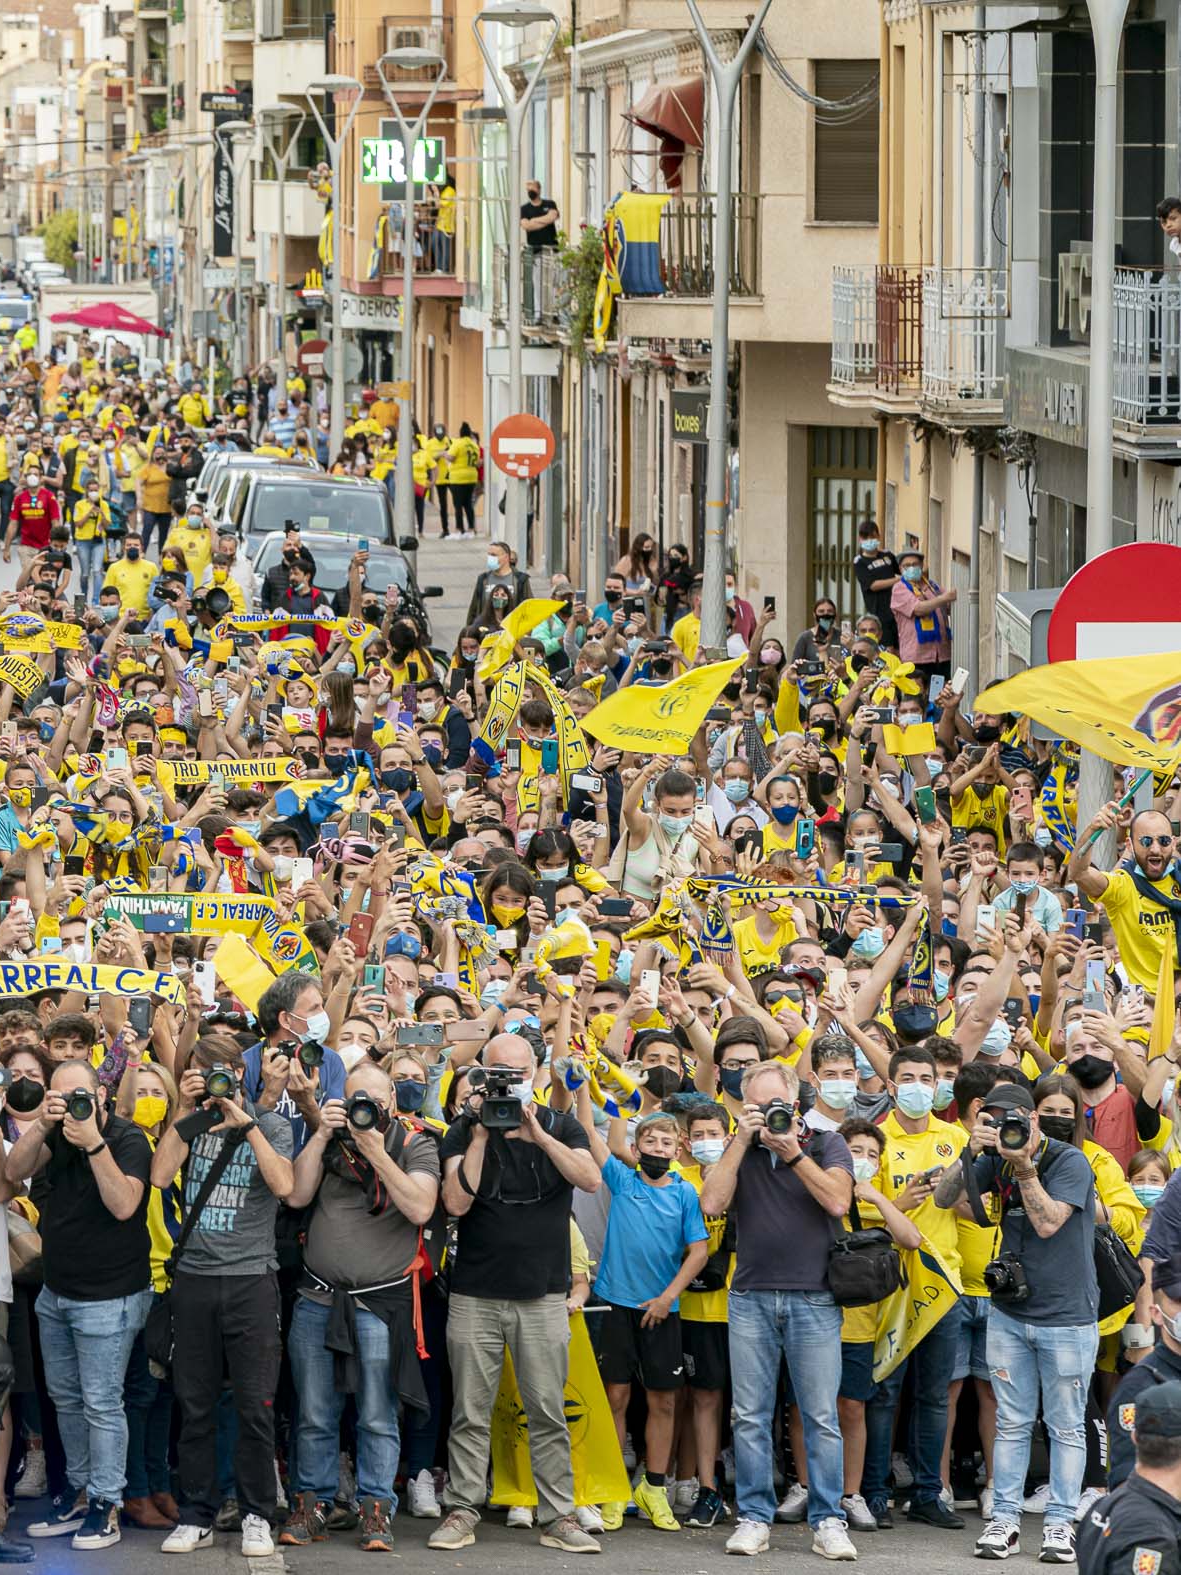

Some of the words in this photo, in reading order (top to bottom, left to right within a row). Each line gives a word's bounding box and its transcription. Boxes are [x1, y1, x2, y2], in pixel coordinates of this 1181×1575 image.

[674, 407, 700, 433] boxes
[232, 614, 269, 623] SOMOS
[207, 761, 276, 777] MOMENTO
